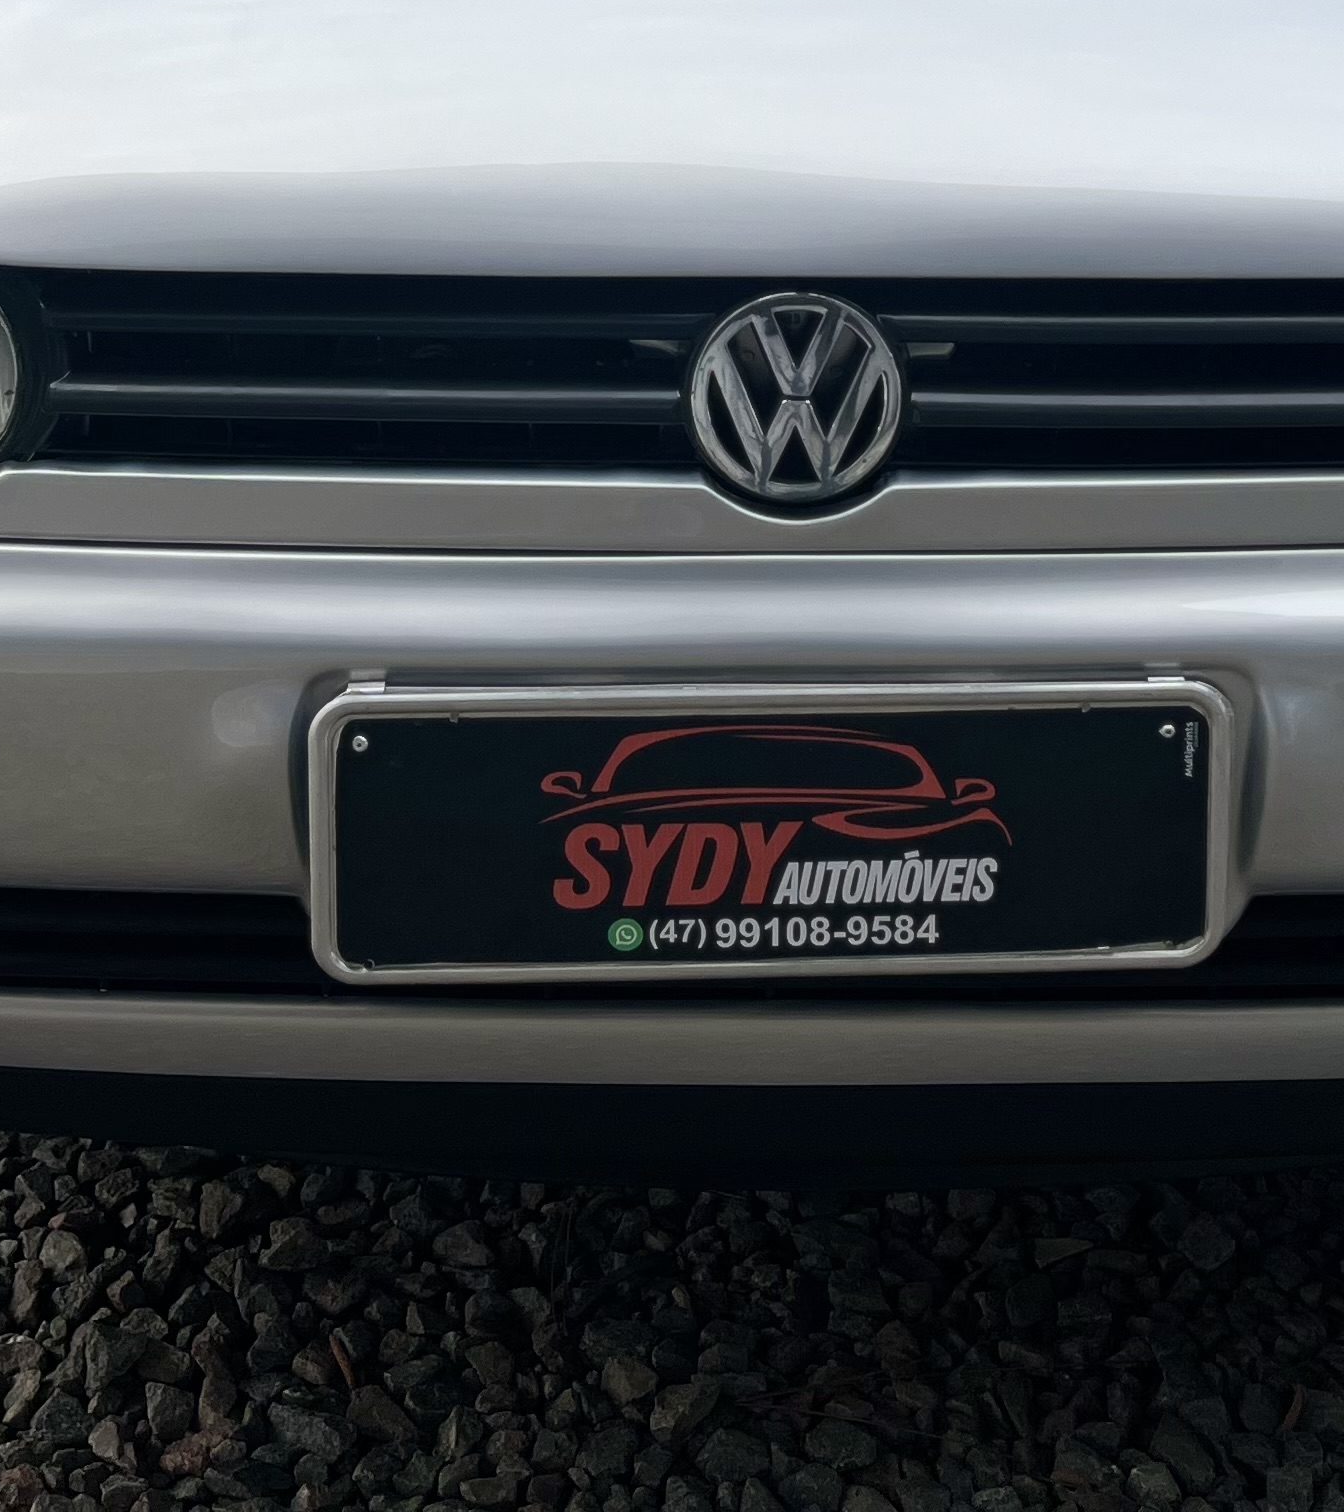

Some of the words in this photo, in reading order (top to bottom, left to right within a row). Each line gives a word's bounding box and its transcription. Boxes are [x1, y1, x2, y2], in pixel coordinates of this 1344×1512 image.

[553, 820, 803, 909] SYDY
[772, 850, 998, 906] AUTOMÓVEIS
[648, 918, 706, 950] (47)
[715, 915, 940, 950] 99108-9584
